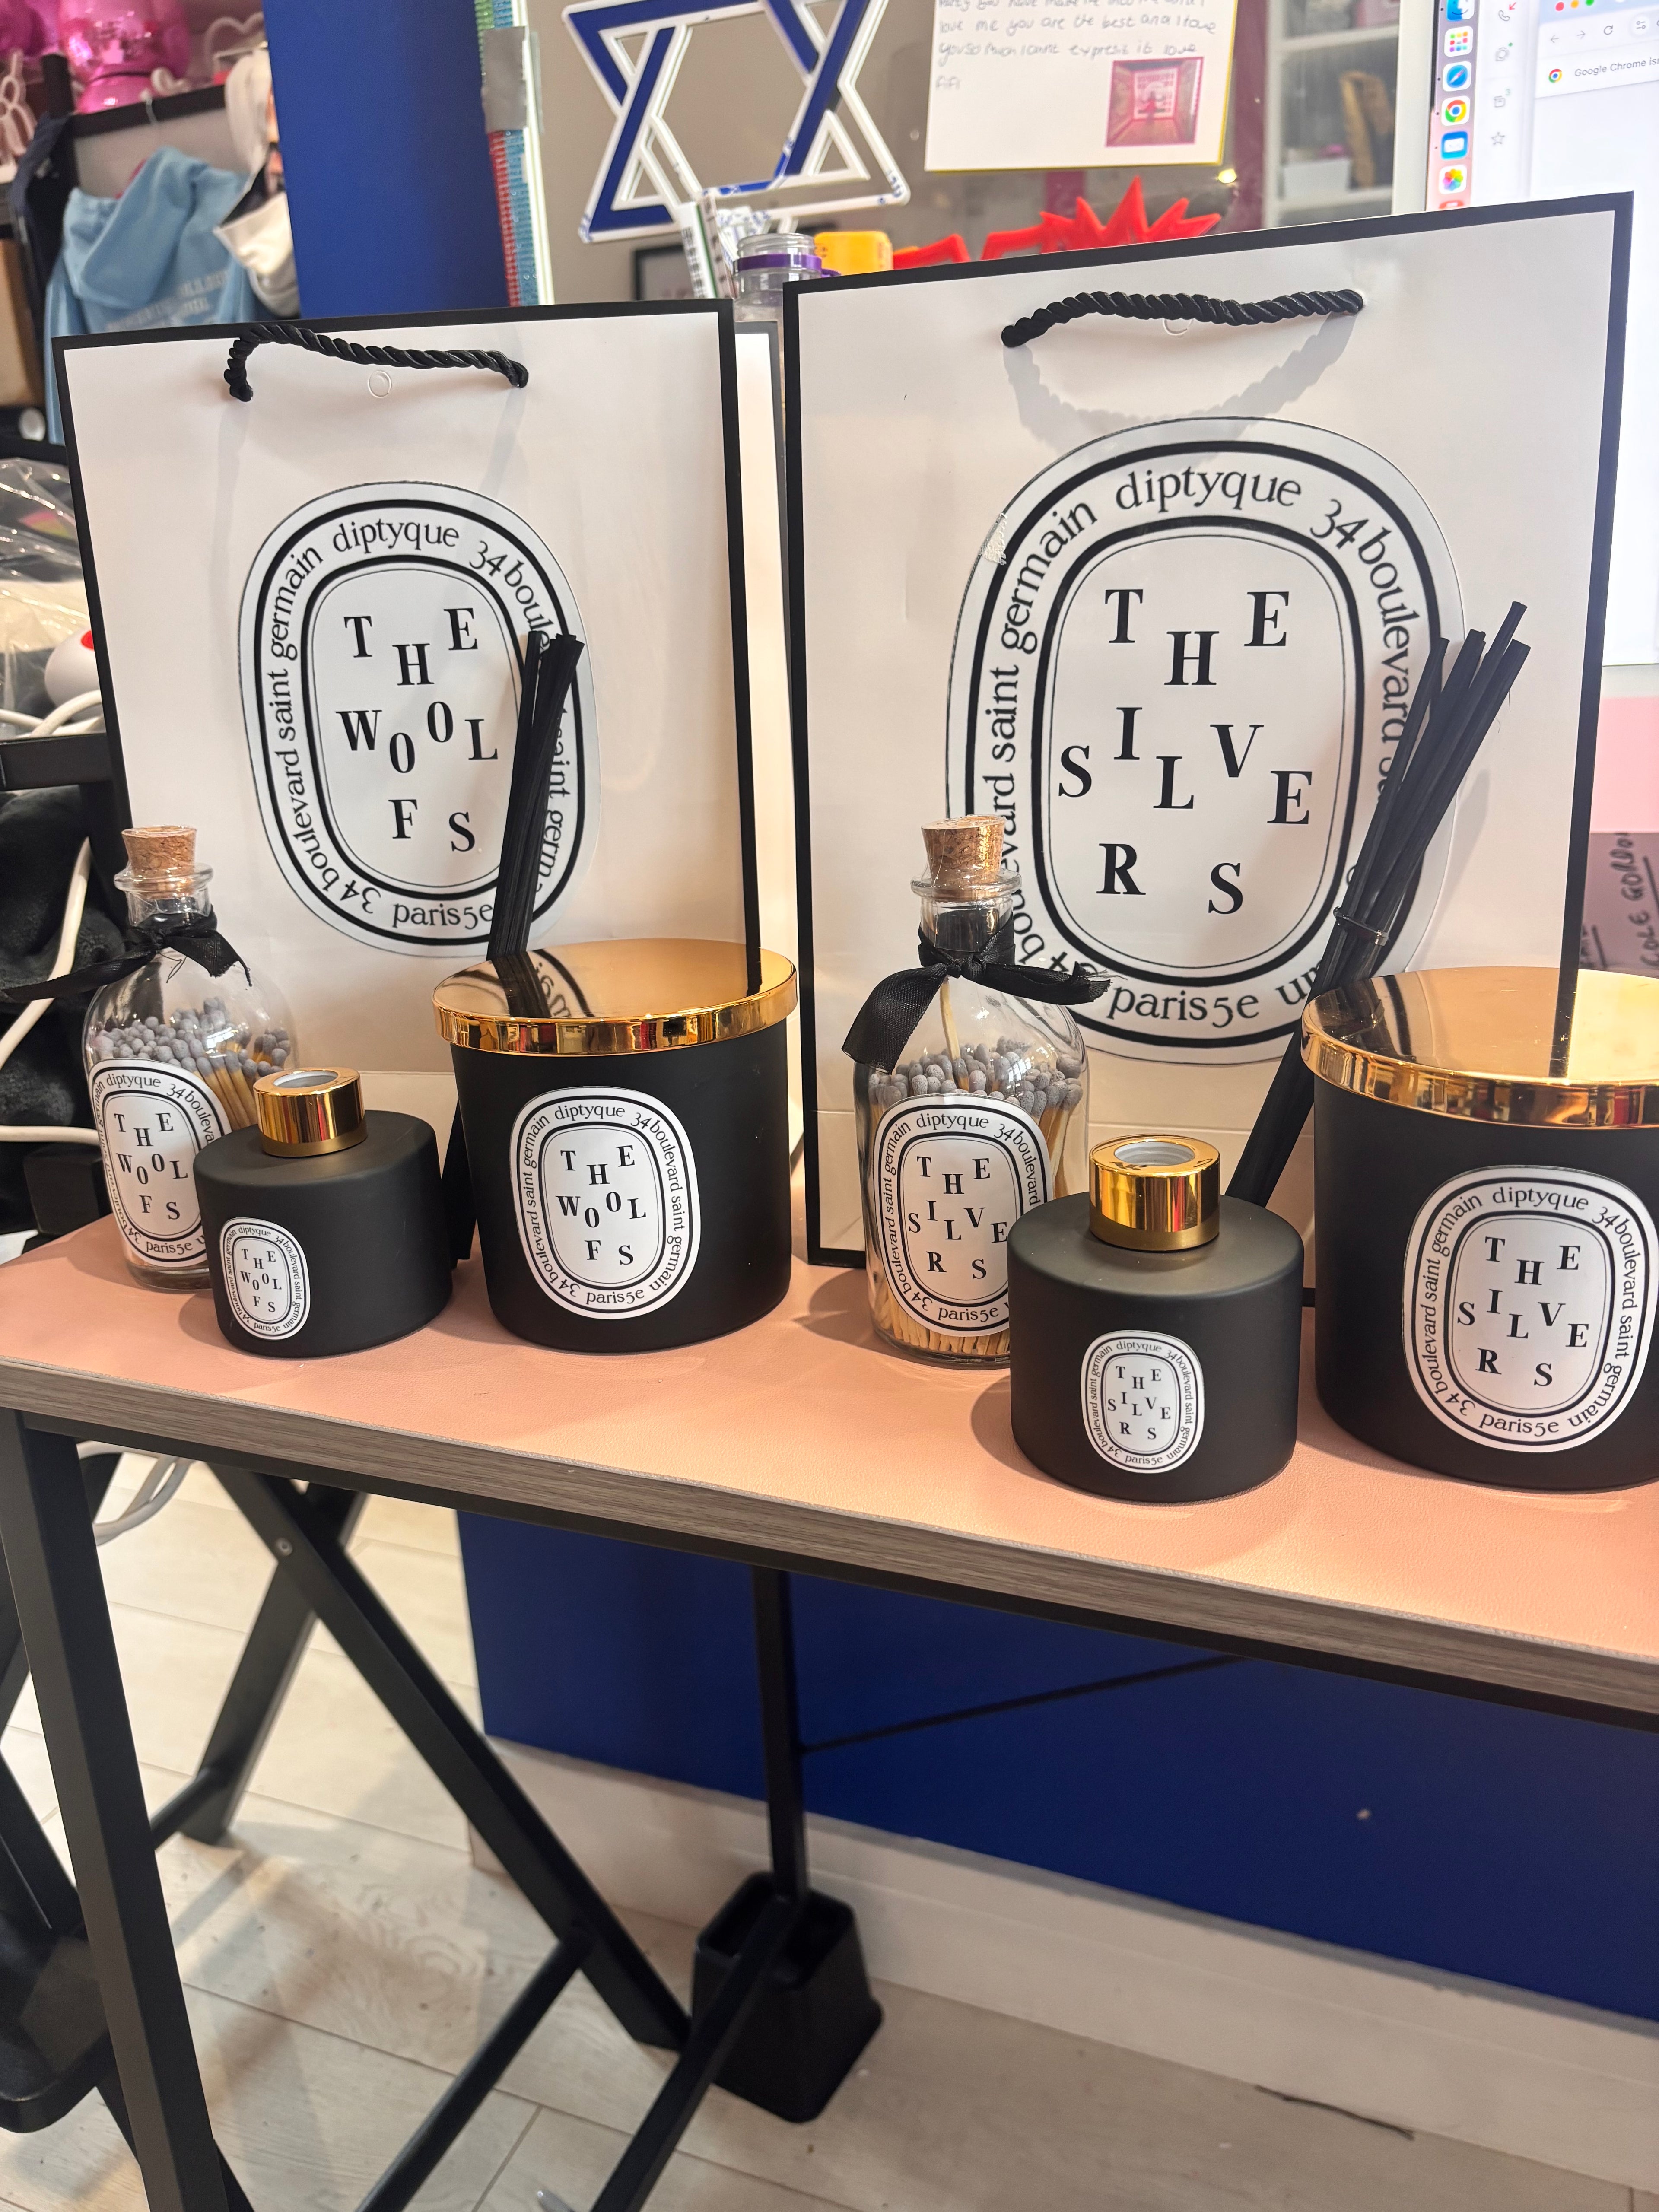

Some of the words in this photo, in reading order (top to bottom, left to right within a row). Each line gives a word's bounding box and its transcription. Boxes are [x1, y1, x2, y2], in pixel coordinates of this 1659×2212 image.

[1006, 19, 1034, 37] you
[1041, 17, 1065, 30] are
[1102, 14, 1135, 29] best
[1575, 65, 1607, 76] Google
[1610, 60, 1646, 71] Chrome
[1116, 466, 1302, 512] diptyque
[333, 519, 460, 555] diptyque
[1310, 499, 1369, 549] 34
[469, 540, 508, 577] 34
[504, 559, 554, 651] boule
[1001, 502, 1098, 655] germain
[270, 546, 324, 661] germain
[267, 669, 297, 742] saint
[985, 664, 1020, 763] saint
[275, 748, 341, 893] boulevard
[340, 878, 381, 915] 34
[1106, 985, 1259, 1027] paris5e
[106, 1074, 161, 1089] diptyque
[166, 1083, 186, 1099] 34
[184, 1090, 215, 1143] bouleva
[554, 1104, 626, 1122] diptyque
[631, 1112, 651, 1129] 34
[916, 1113, 989, 1131] diptyque
[524, 1115, 550, 1169] germain
[649, 1120, 683, 1193] boulevard
[883, 1122, 912, 1176] germain
[994, 1123, 1014, 1141] 34
[1013, 1131, 1042, 1206] boulevard
[523, 1171, 536, 1208] saint
[883, 1177, 895, 1214] saint
[1493, 1186, 1589, 1211] diptyque
[238, 1226, 271, 1237] diptyque
[671, 1195, 686, 1232] saint
[1432, 1194, 1483, 1258] germain
[1592, 1206, 1619, 1227] 34
[146, 1241, 193, 1255] paris5e
[526, 1210, 559, 1284] boulevard
[648, 1235, 682, 1291] germain
[885, 1217, 912, 1295] boulevard
[1614, 1219, 1641, 1310] boulevard
[282, 1241, 302, 1280] boulevard
[294, 1281, 303, 1300] saint
[559, 1279, 581, 1297] 34
[1424, 1258, 1441, 1303] saint
[585, 1288, 645, 1305] paris5e
[910, 1290, 933, 1311] 34
[938, 1306, 999, 1322] paris5e
[1116, 1341, 1162, 1352] diptyque
[1421, 1304, 1449, 1394] boulevard
[1614, 1314, 1633, 1359] saint
[1091, 1344, 1113, 1377] germain
[1176, 1356, 1194, 1400] boulevard
[1089, 1379, 1098, 1401] saint
[1443, 1392, 1476, 1416] 34
[1567, 1362, 1622, 1427] germain
[1089, 1402, 1108, 1449] boulevard
[1185, 1402, 1194, 1425] saint
[1478, 1412, 1560, 1437] paris5e
[1125, 1455, 1163, 1465] paris5e
[1166, 1426, 1191, 1460] germain
